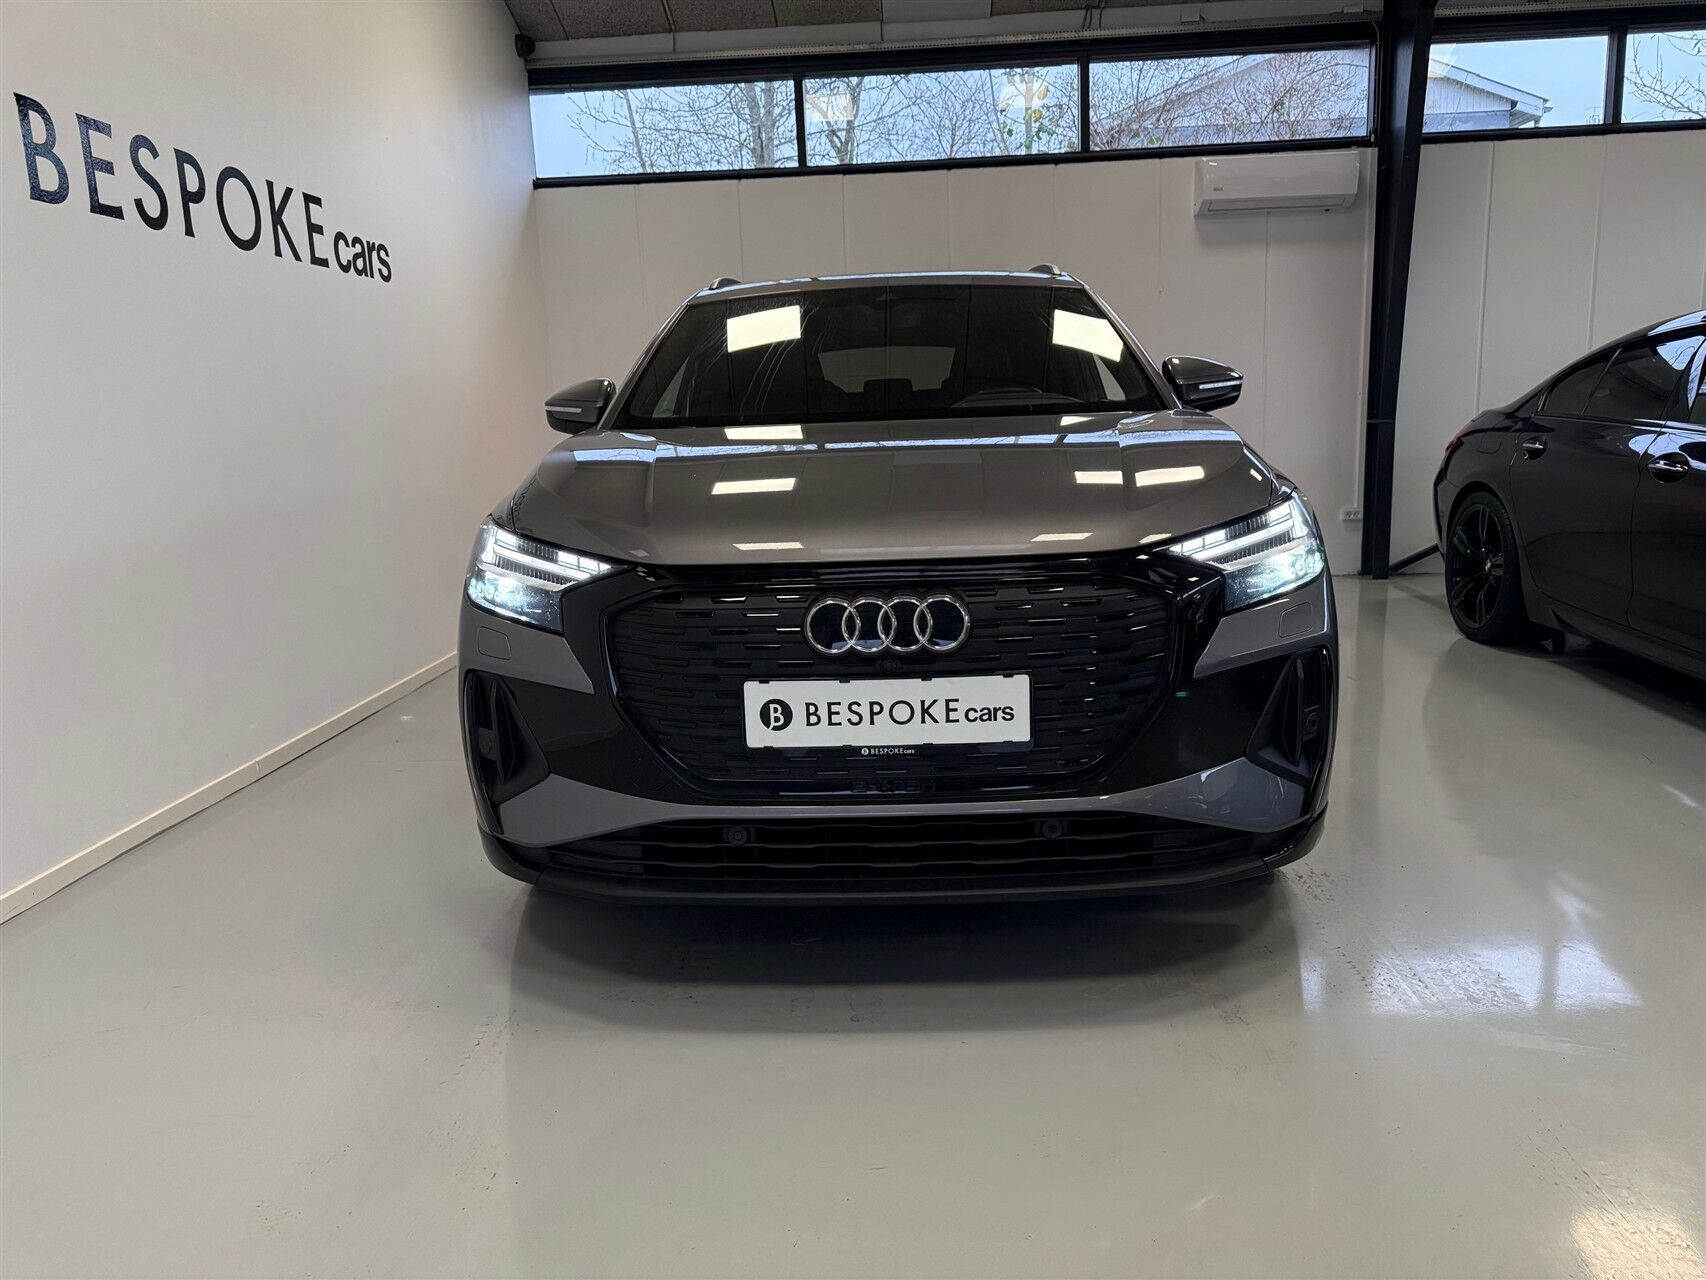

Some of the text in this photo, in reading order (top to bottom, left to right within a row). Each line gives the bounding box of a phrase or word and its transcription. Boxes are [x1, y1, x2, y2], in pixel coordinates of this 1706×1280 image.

[13, 92, 391, 283] BESPOKE cars
[804, 699, 960, 727] BESPOKE
[964, 705, 1015, 722] cars
